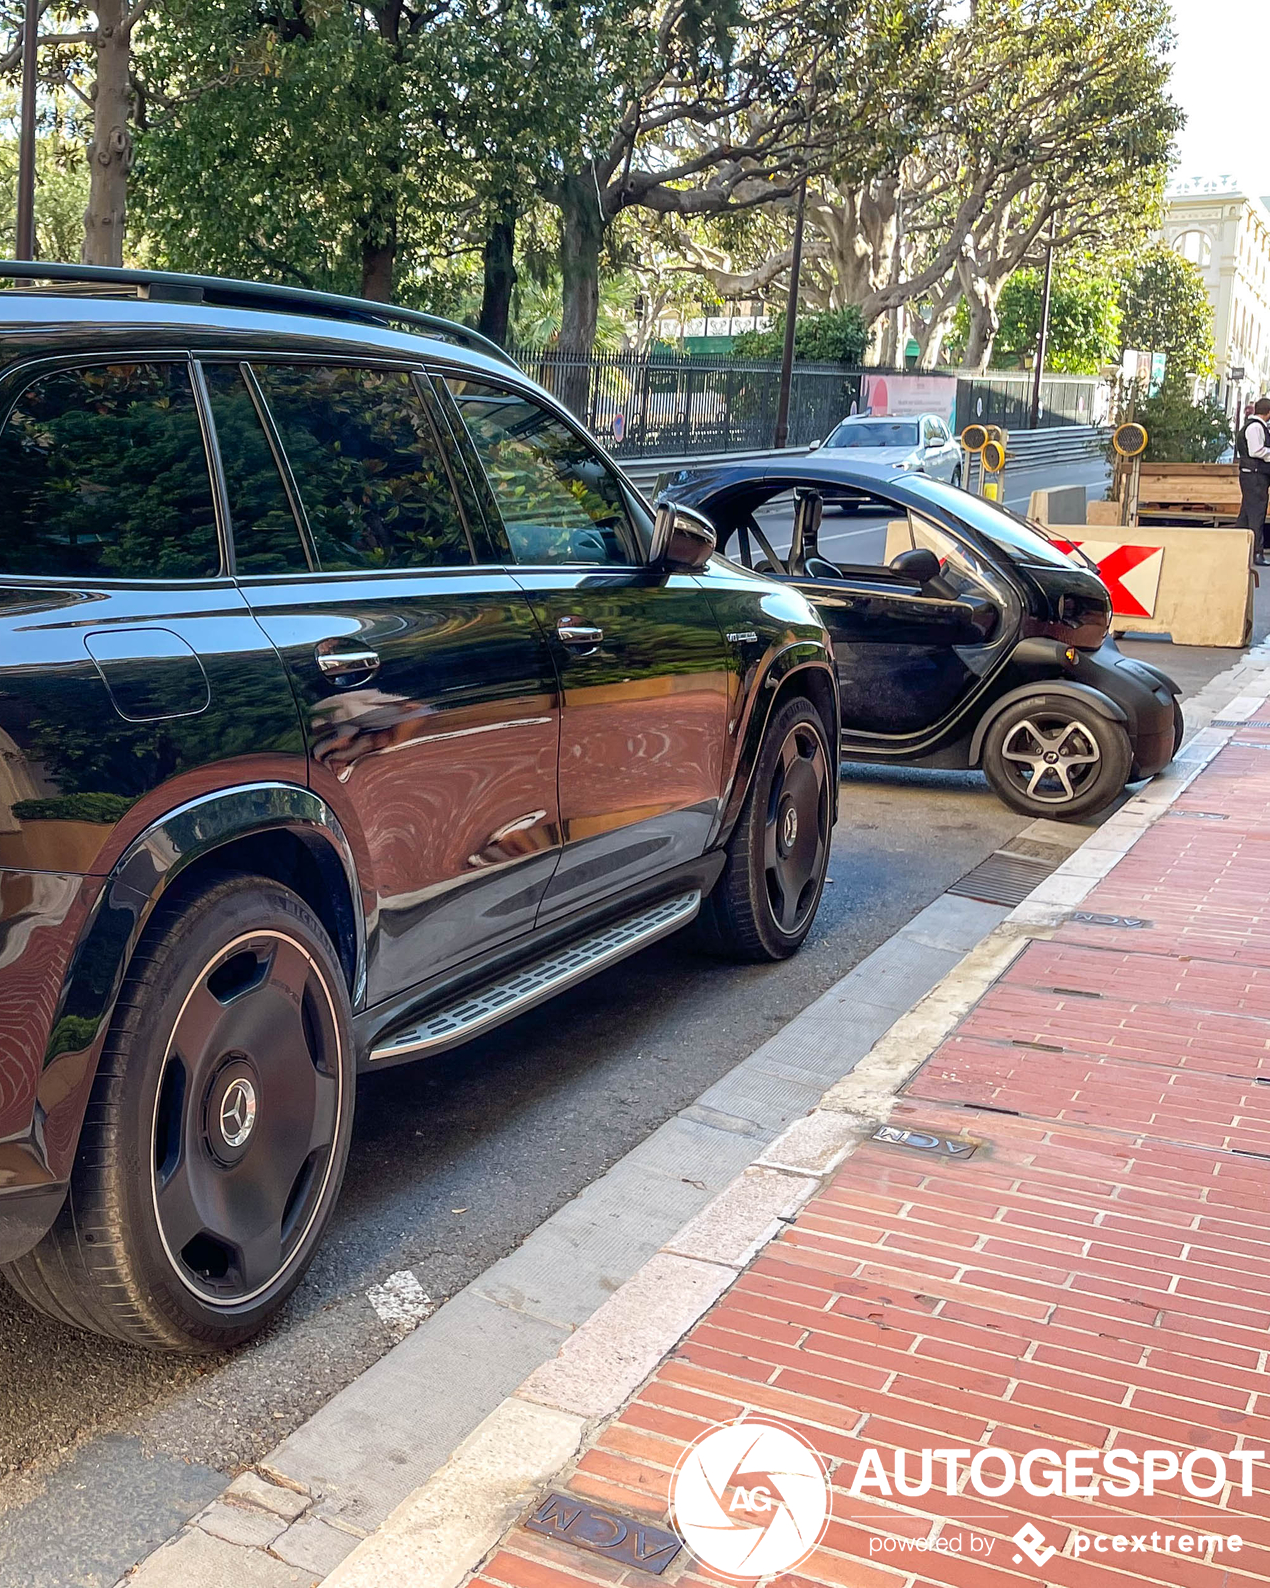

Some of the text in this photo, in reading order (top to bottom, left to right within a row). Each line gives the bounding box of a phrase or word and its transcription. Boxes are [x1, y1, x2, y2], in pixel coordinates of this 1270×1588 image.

[1074, 912, 1141, 927] ACM
[877, 1125, 972, 1154] ACM
[535, 1500, 676, 1561] ACM
